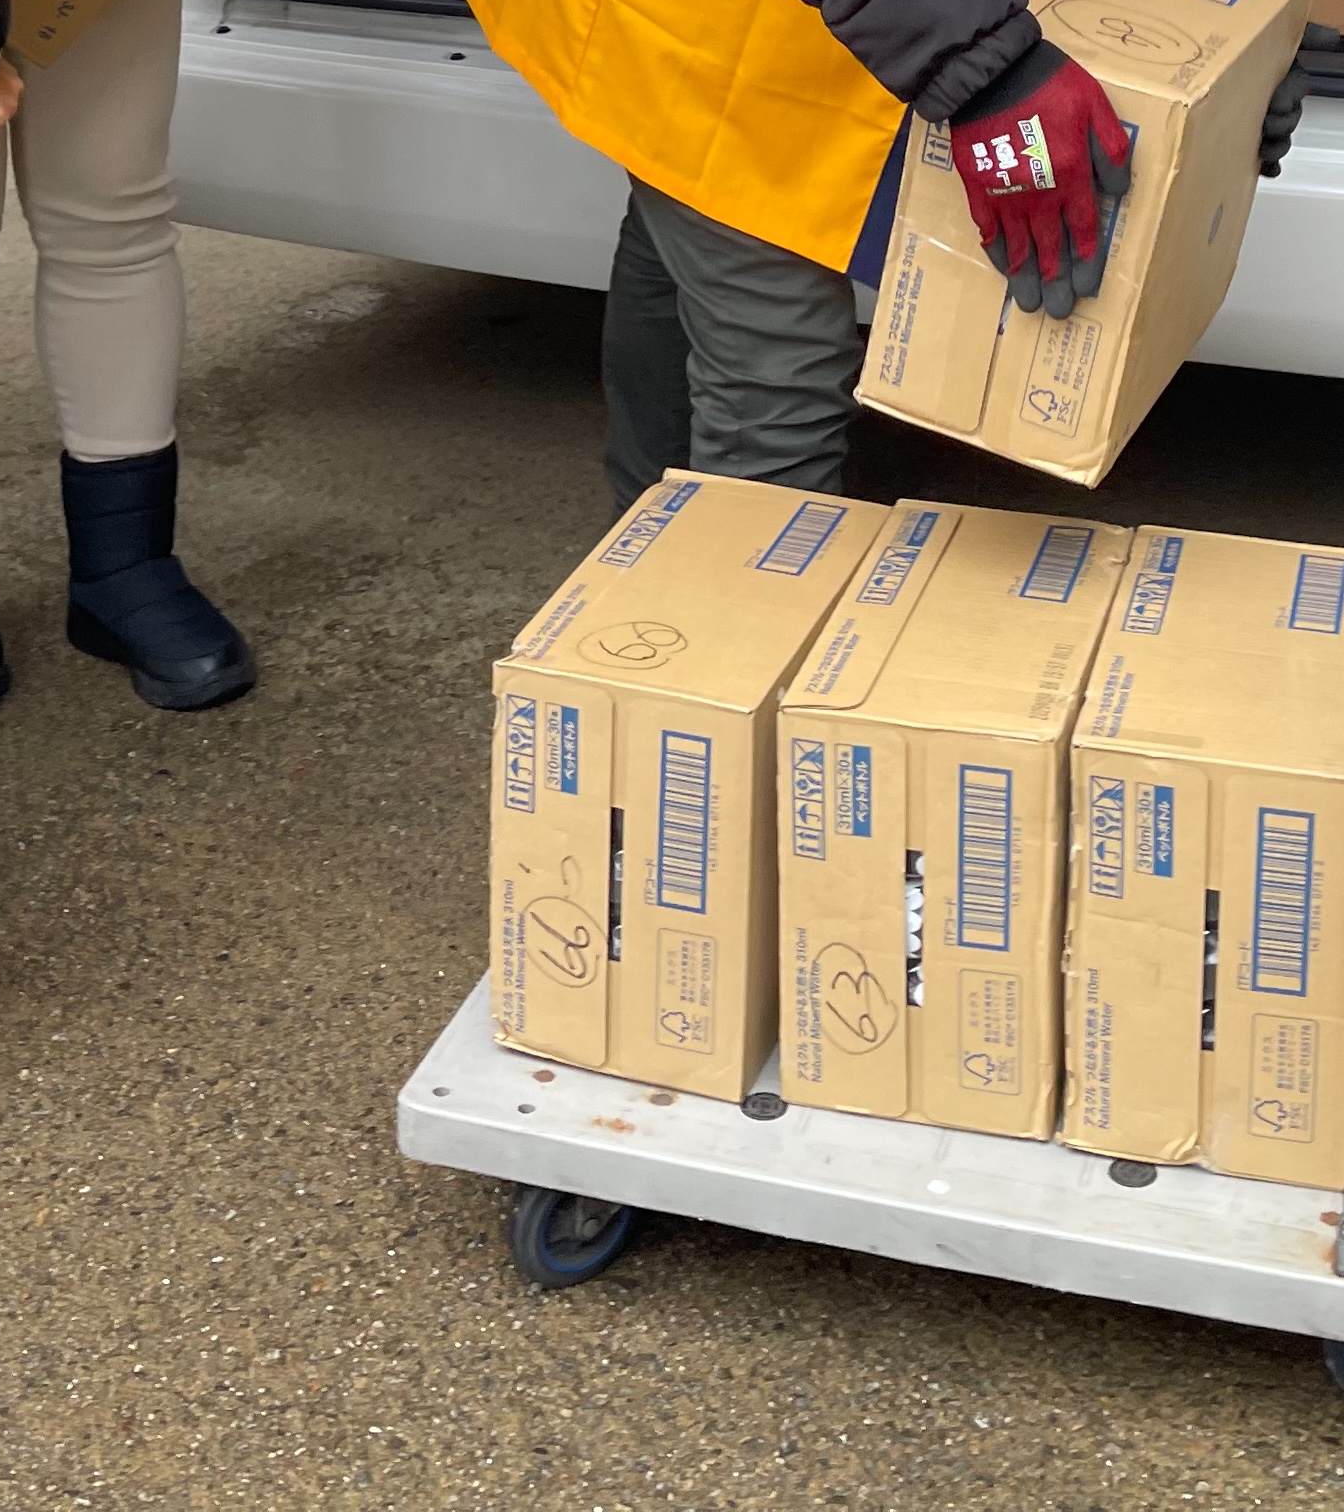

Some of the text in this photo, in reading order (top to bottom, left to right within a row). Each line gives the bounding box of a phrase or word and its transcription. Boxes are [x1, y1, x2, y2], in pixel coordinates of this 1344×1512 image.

[902, 232, 918, 268] 310ml
[891, 265, 924, 388] Natural Mineral Water
[1056, 395, 1072, 424] FSC
[563, 719, 578, 781] ペットボトル
[855, 760, 870, 823] ペットボトル
[1156, 800, 1171, 863] ペットボトル
[503, 879, 515, 909] 310ml
[513, 913, 527, 1034] Natural Mineral Water
[796, 928, 807, 962] 310ml
[826, 971, 889, 1043] 63
[1089, 968, 1101, 1003] 310ml
[809, 959, 822, 1084] Natural Mineral Water
[1098, 1001, 1114, 1130] Natural Mineral Water
